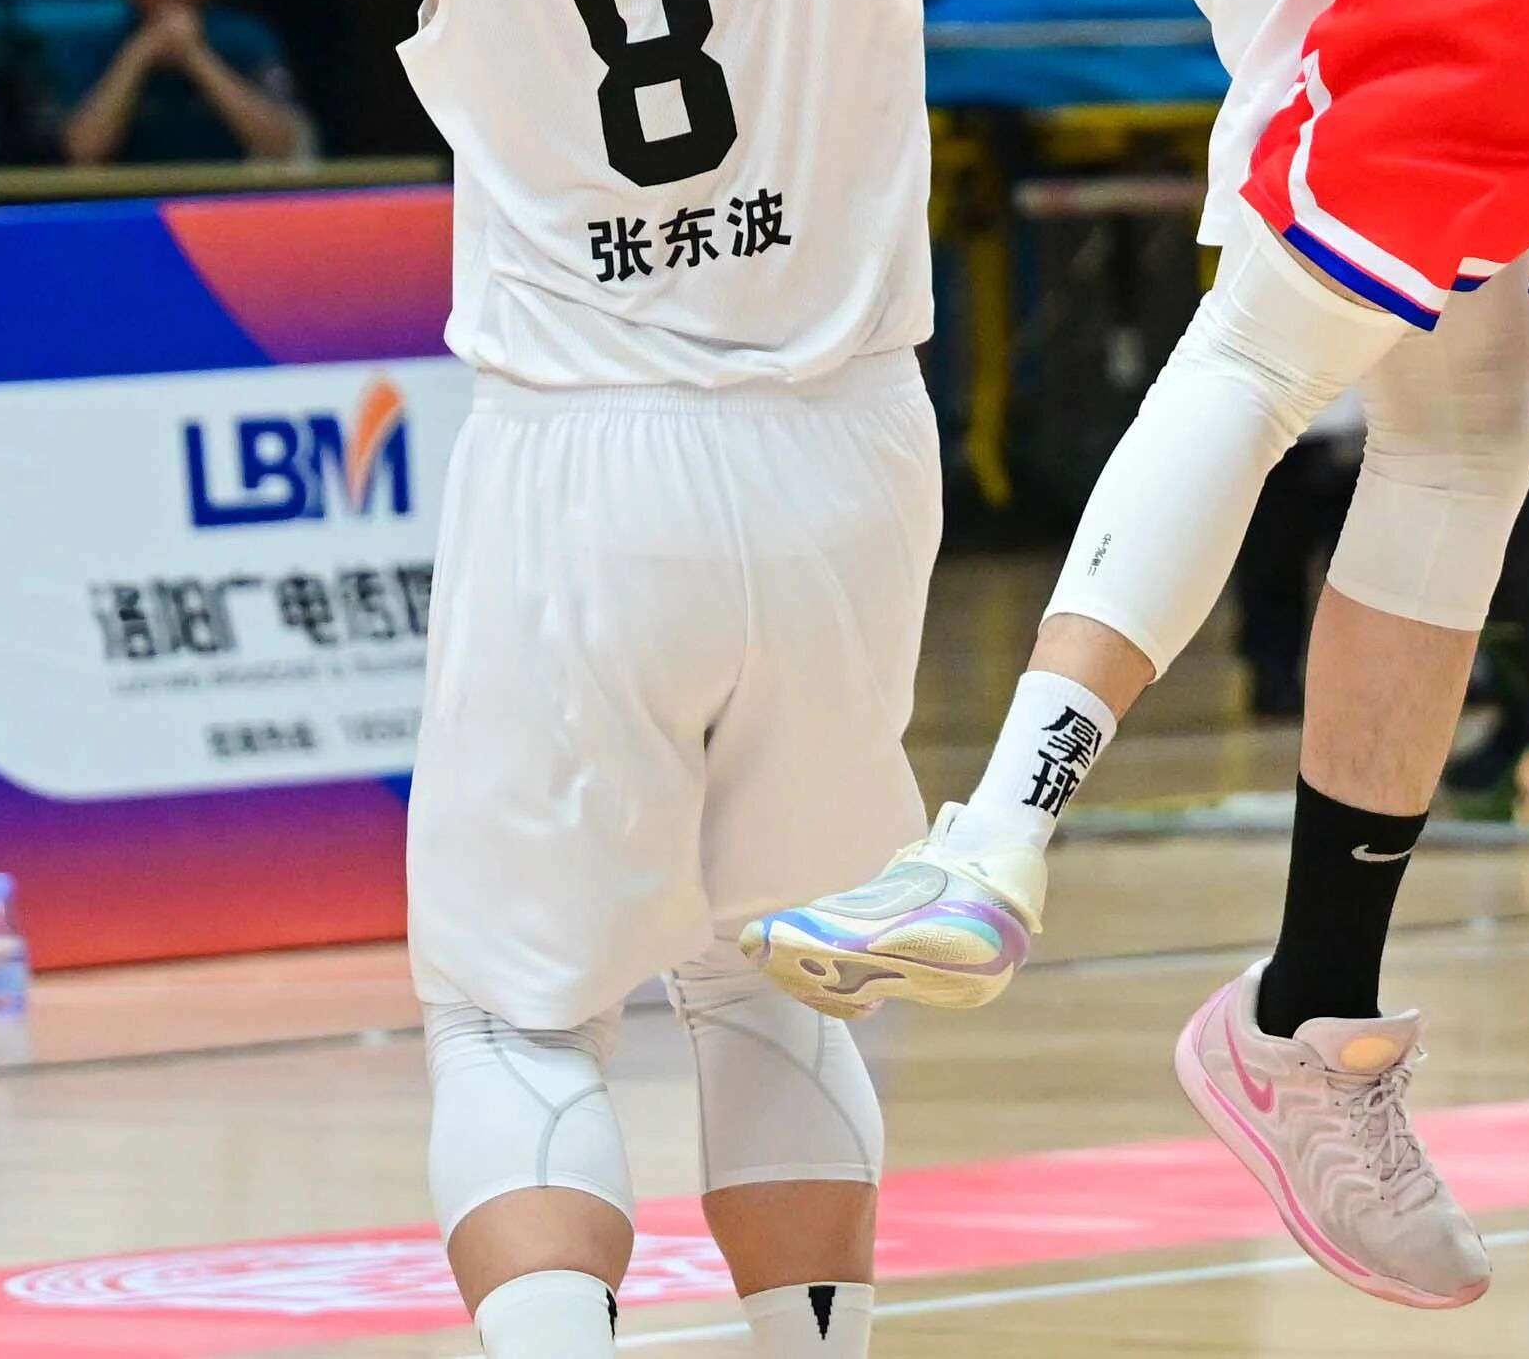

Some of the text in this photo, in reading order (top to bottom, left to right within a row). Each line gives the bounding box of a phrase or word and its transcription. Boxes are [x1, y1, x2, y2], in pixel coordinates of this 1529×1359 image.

[587, 187, 792, 283] 张东波
[182, 381, 414, 529] LBM
